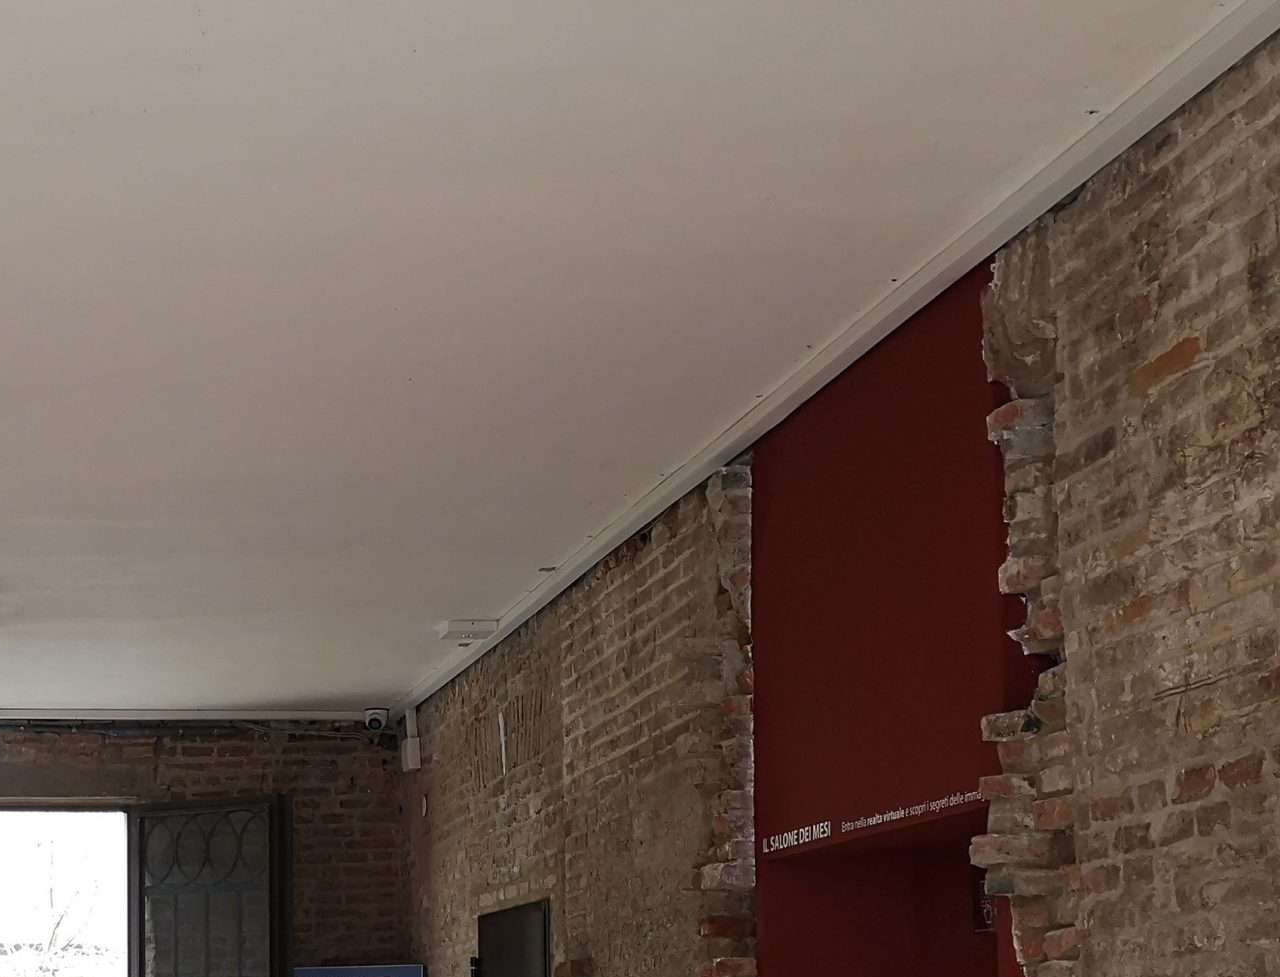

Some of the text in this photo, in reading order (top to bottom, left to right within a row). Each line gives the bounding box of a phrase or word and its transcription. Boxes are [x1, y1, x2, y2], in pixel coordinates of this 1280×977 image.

[883, 808, 903, 822] virtuale
[910, 802, 925, 816] scopri
[929, 796, 948, 812] segreti
[949, 792, 963, 806] delle
[762, 821, 830, 852] IL SALONE DEI MESI
